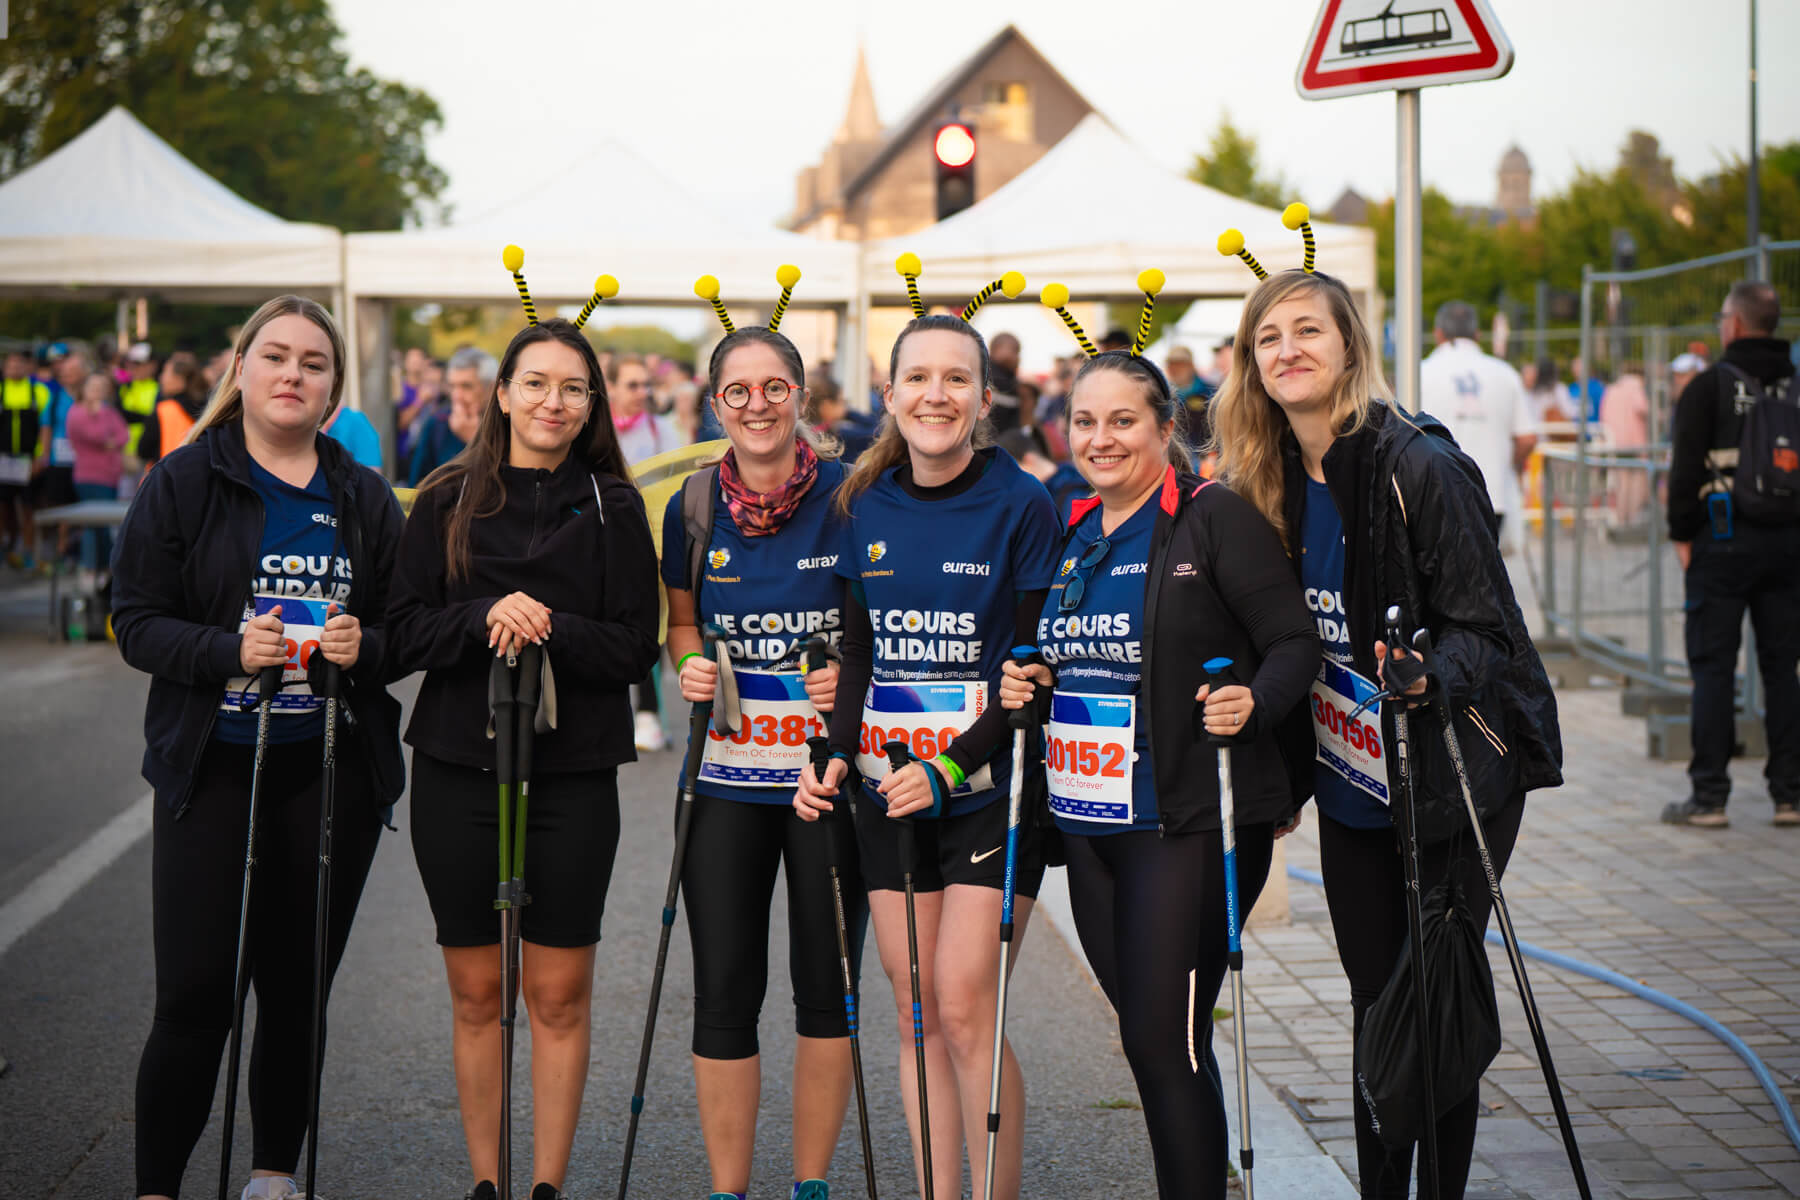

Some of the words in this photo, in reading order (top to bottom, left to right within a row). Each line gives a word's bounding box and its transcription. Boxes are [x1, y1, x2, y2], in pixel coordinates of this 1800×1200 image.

[942, 560, 991, 576] euraxi
[1111, 562, 1148, 577] eurax
[741, 608, 841, 635] COURS
[884, 609, 976, 636] COURS
[1052, 613, 1131, 639] COURS
[875, 636, 983, 663] OLIDAIRE
[1041, 641, 1143, 665] OLIDAIRE
[1124, 672, 1141, 682] cétos
[1312, 692, 1381, 759] 30156
[724, 745, 748, 758] Team
[750, 748, 766, 758] OC
[768, 749, 802, 759] forever
[1046, 735, 1125, 778] 30152
[1064, 777, 1076, 788] OC
[1076, 779, 1104, 790] forever
